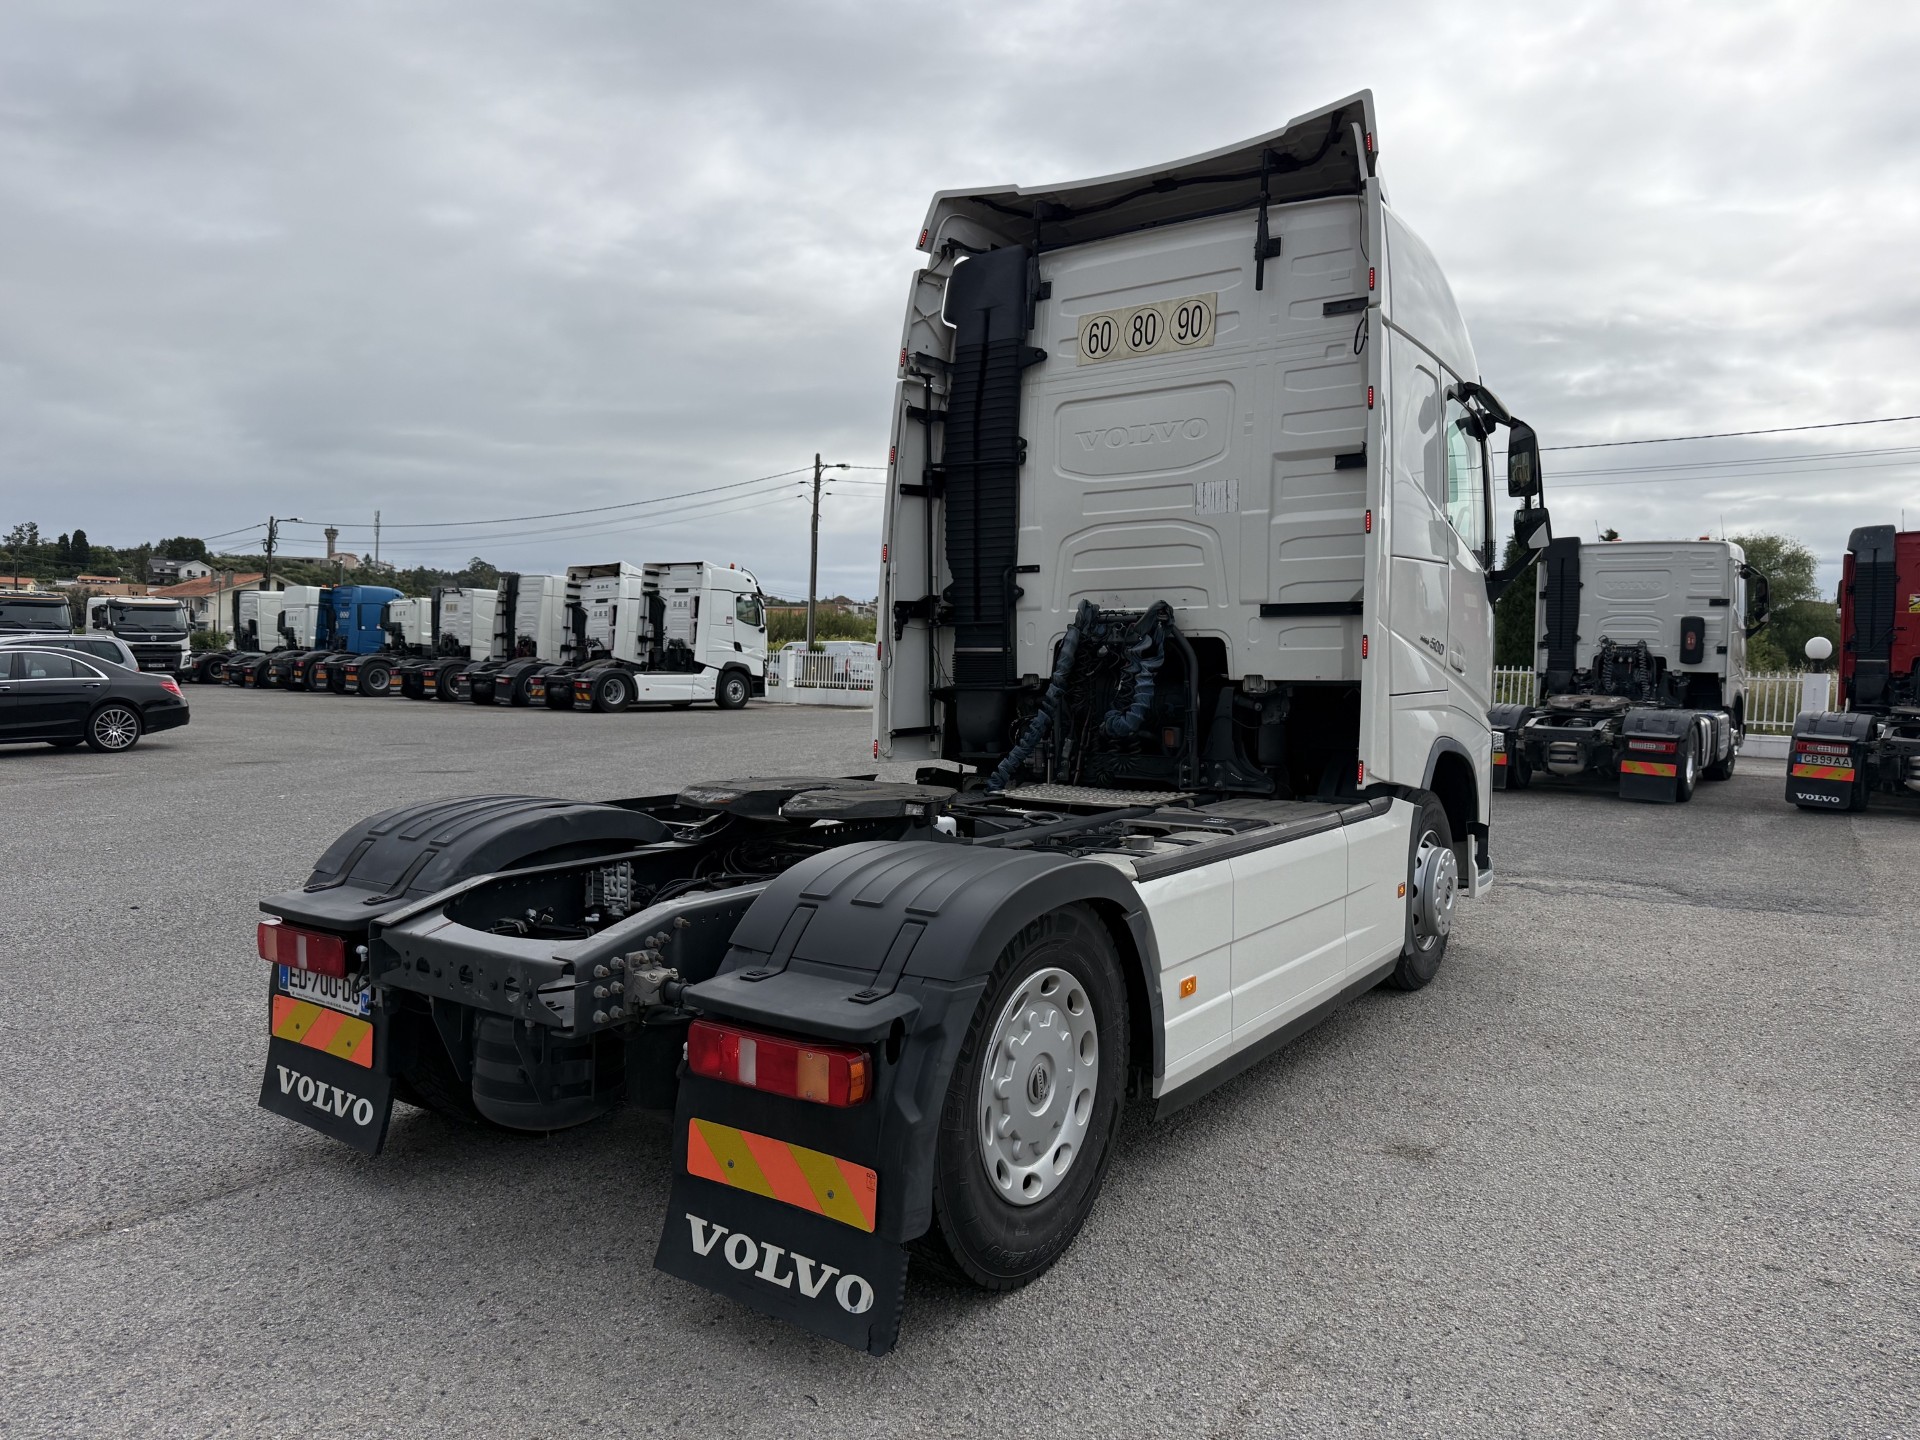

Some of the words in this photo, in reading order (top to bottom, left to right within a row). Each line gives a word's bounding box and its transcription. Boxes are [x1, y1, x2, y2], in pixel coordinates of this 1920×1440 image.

[1088, 321, 1112, 354] 60
[1131, 313, 1156, 347] 80
[1177, 305, 1203, 340] 90
[1075, 417, 1209, 451] VOLVO
[1429, 637, 1445, 656] 500
[1796, 792, 1840, 803] VOLVO
[276, 1064, 374, 1126] VOLVO
[685, 1212, 875, 1314] VOLVO
